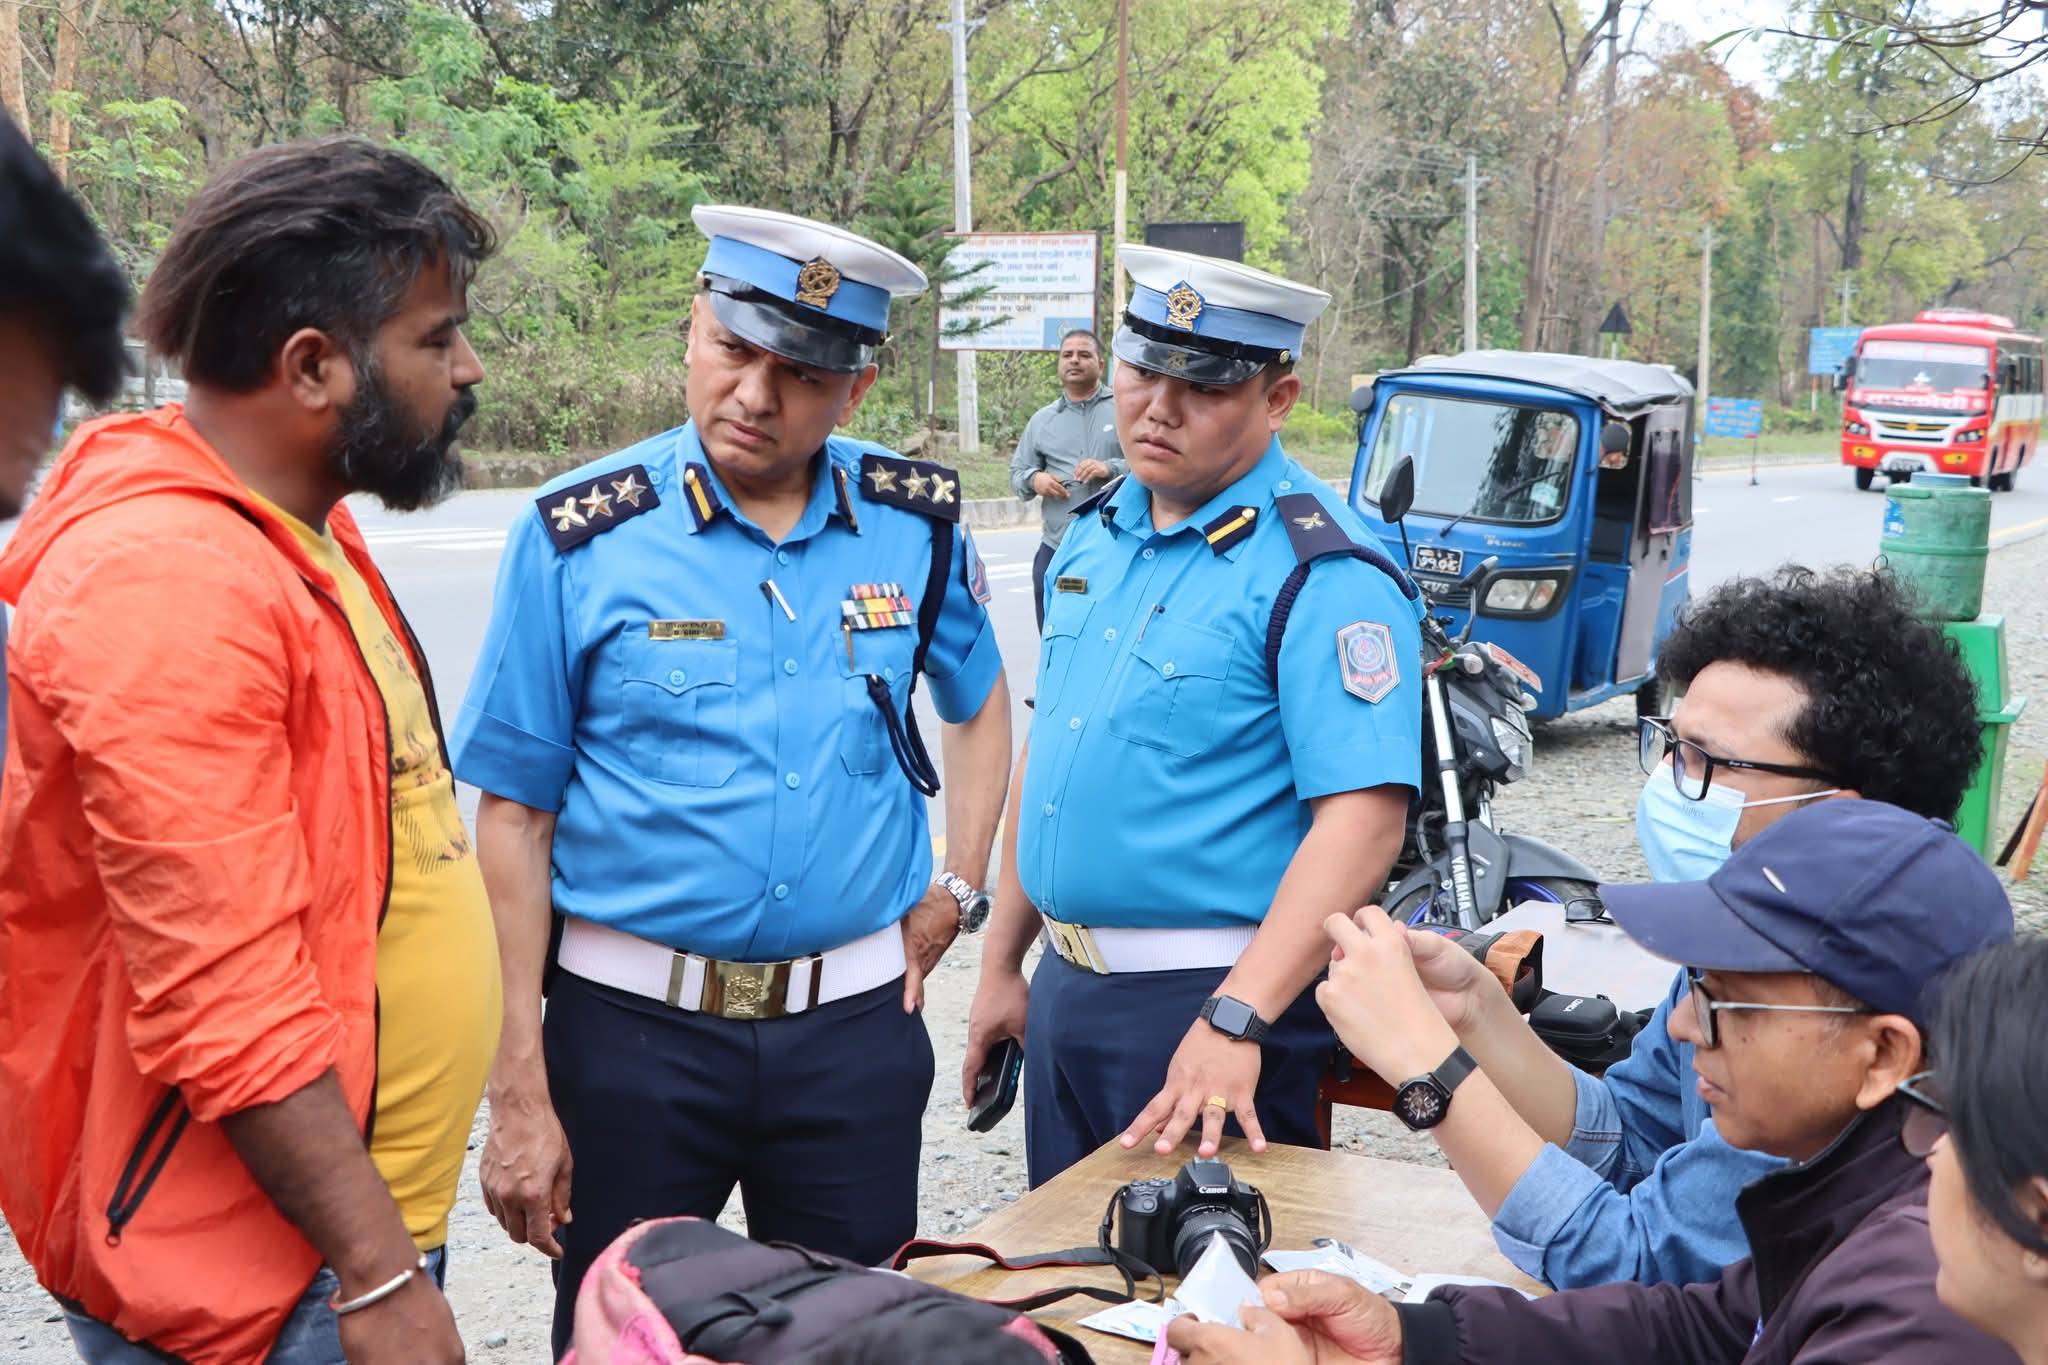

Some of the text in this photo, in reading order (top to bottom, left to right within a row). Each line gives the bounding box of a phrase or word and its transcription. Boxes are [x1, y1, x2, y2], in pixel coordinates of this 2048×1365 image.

[1421, 580, 1449, 593] TVS
[1452, 856, 1471, 911] YAMAHA
[1198, 1186, 1228, 1194] Canon
